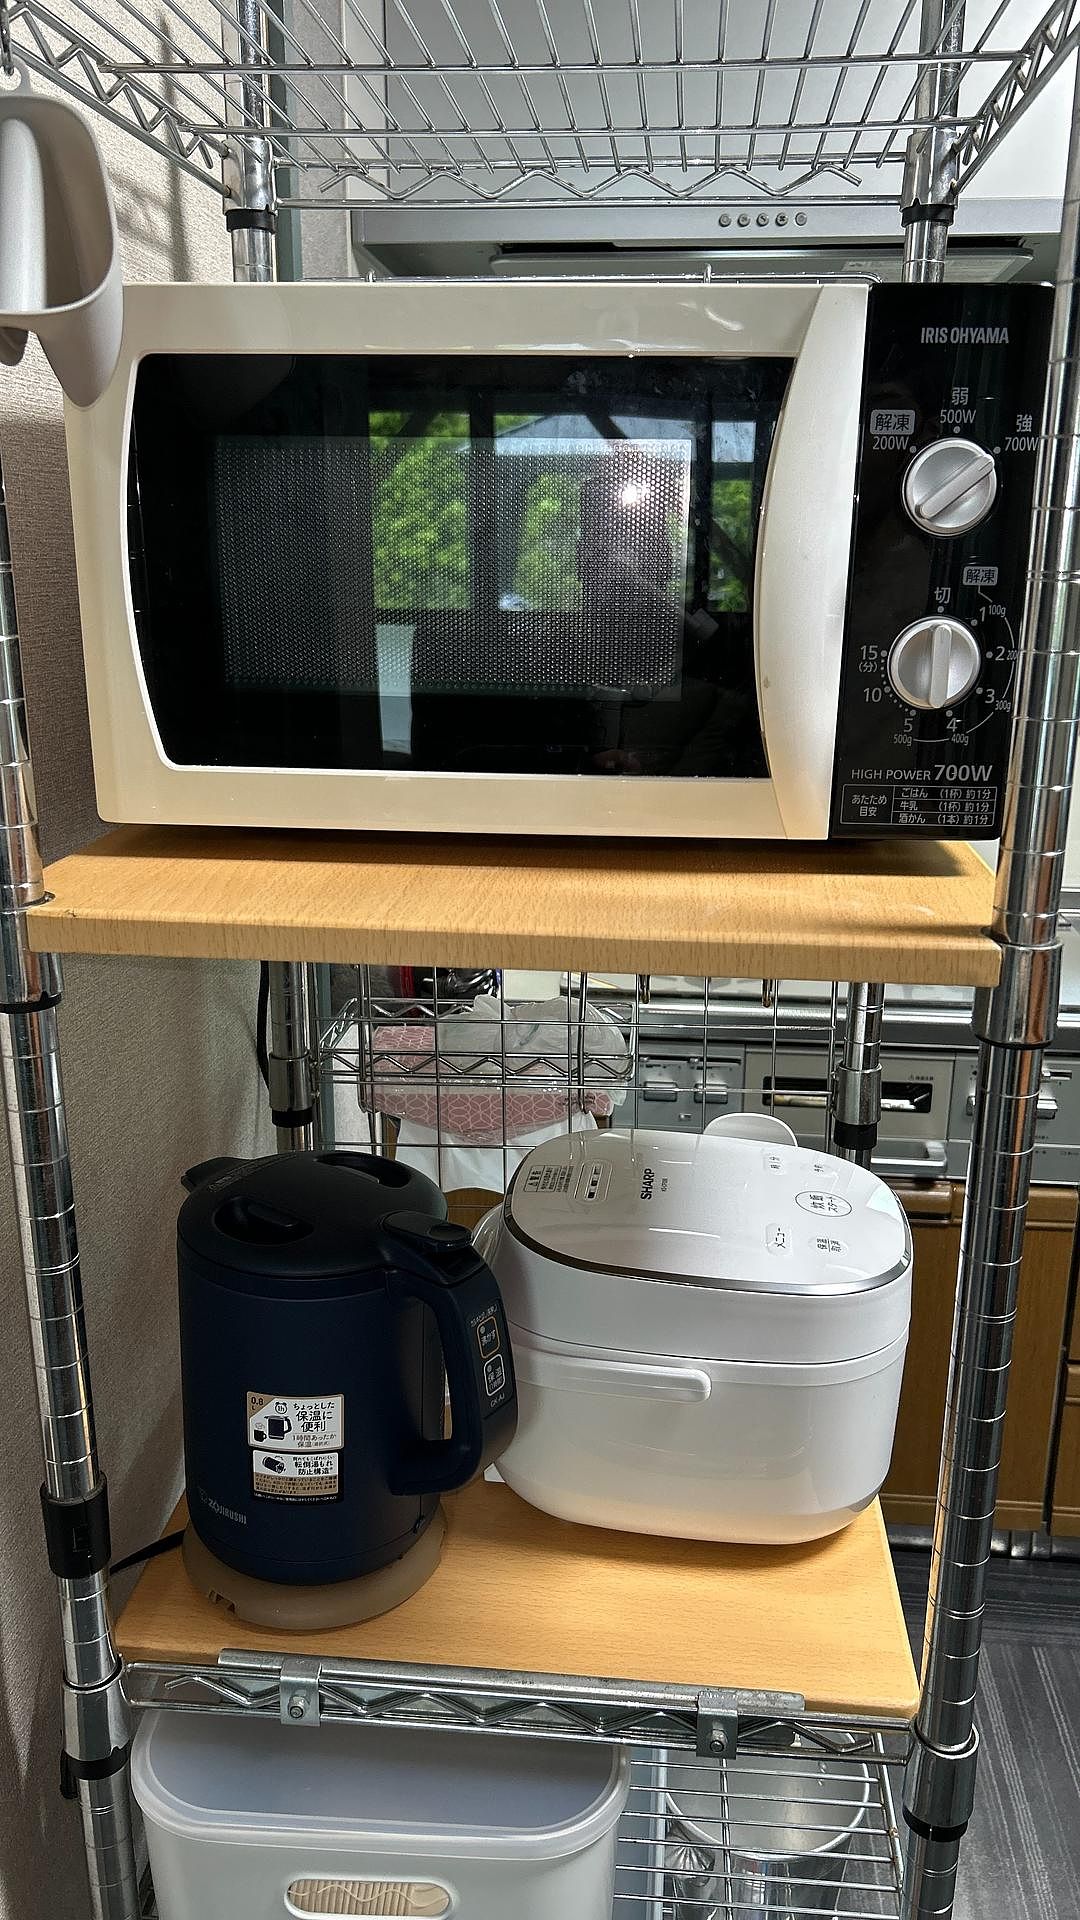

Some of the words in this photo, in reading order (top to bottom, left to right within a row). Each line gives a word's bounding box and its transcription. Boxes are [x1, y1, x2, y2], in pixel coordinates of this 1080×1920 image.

[920, 327, 948, 344] IRIS
[950, 327, 1009, 344] OHYAMA
[951, 387, 969, 406] 弱
[873, 413, 911, 432] 解凍
[939, 409, 976, 424] 500W
[1015, 414, 1033, 433] 強
[872, 435, 909, 450] 200W
[1004, 437, 1039, 451] 700W
[966, 568, 996, 584] 解凍
[934, 587, 951, 603] 切
[979, 606, 986, 622] 1
[988, 604, 1006, 618] 100g
[860, 645, 878, 660] 15
[994, 645, 1006, 661] 2
[863, 687, 882, 702] 10
[984, 688, 995, 704] 3
[903, 718, 913, 733] 5
[946, 718, 958, 732] 4
[893, 733, 912, 747] 500g
[951, 733, 969, 746] 400g
[851, 769, 882, 780] HIGH
[886, 769, 931, 781] POWER
[934, 764, 993, 781] 700W
[851, 794, 888, 805] あたため
[901, 788, 928, 798] ごはん
[859, 806, 877, 817] 目安
[900, 801, 918, 811] 牛乳
[899, 813, 926, 824] 酒かん
[640, 1168, 655, 1200] SHARP
[774, 1227, 786, 1249] メニュー
[250, 1396, 264, 1406] 0.8
[293, 1401, 335, 1411] ちょっとした
[296, 1410, 333, 1421] 保温に
[301, 1421, 326, 1433] 便利
[208, 1497, 247, 1525] ZOJIRUSHI
